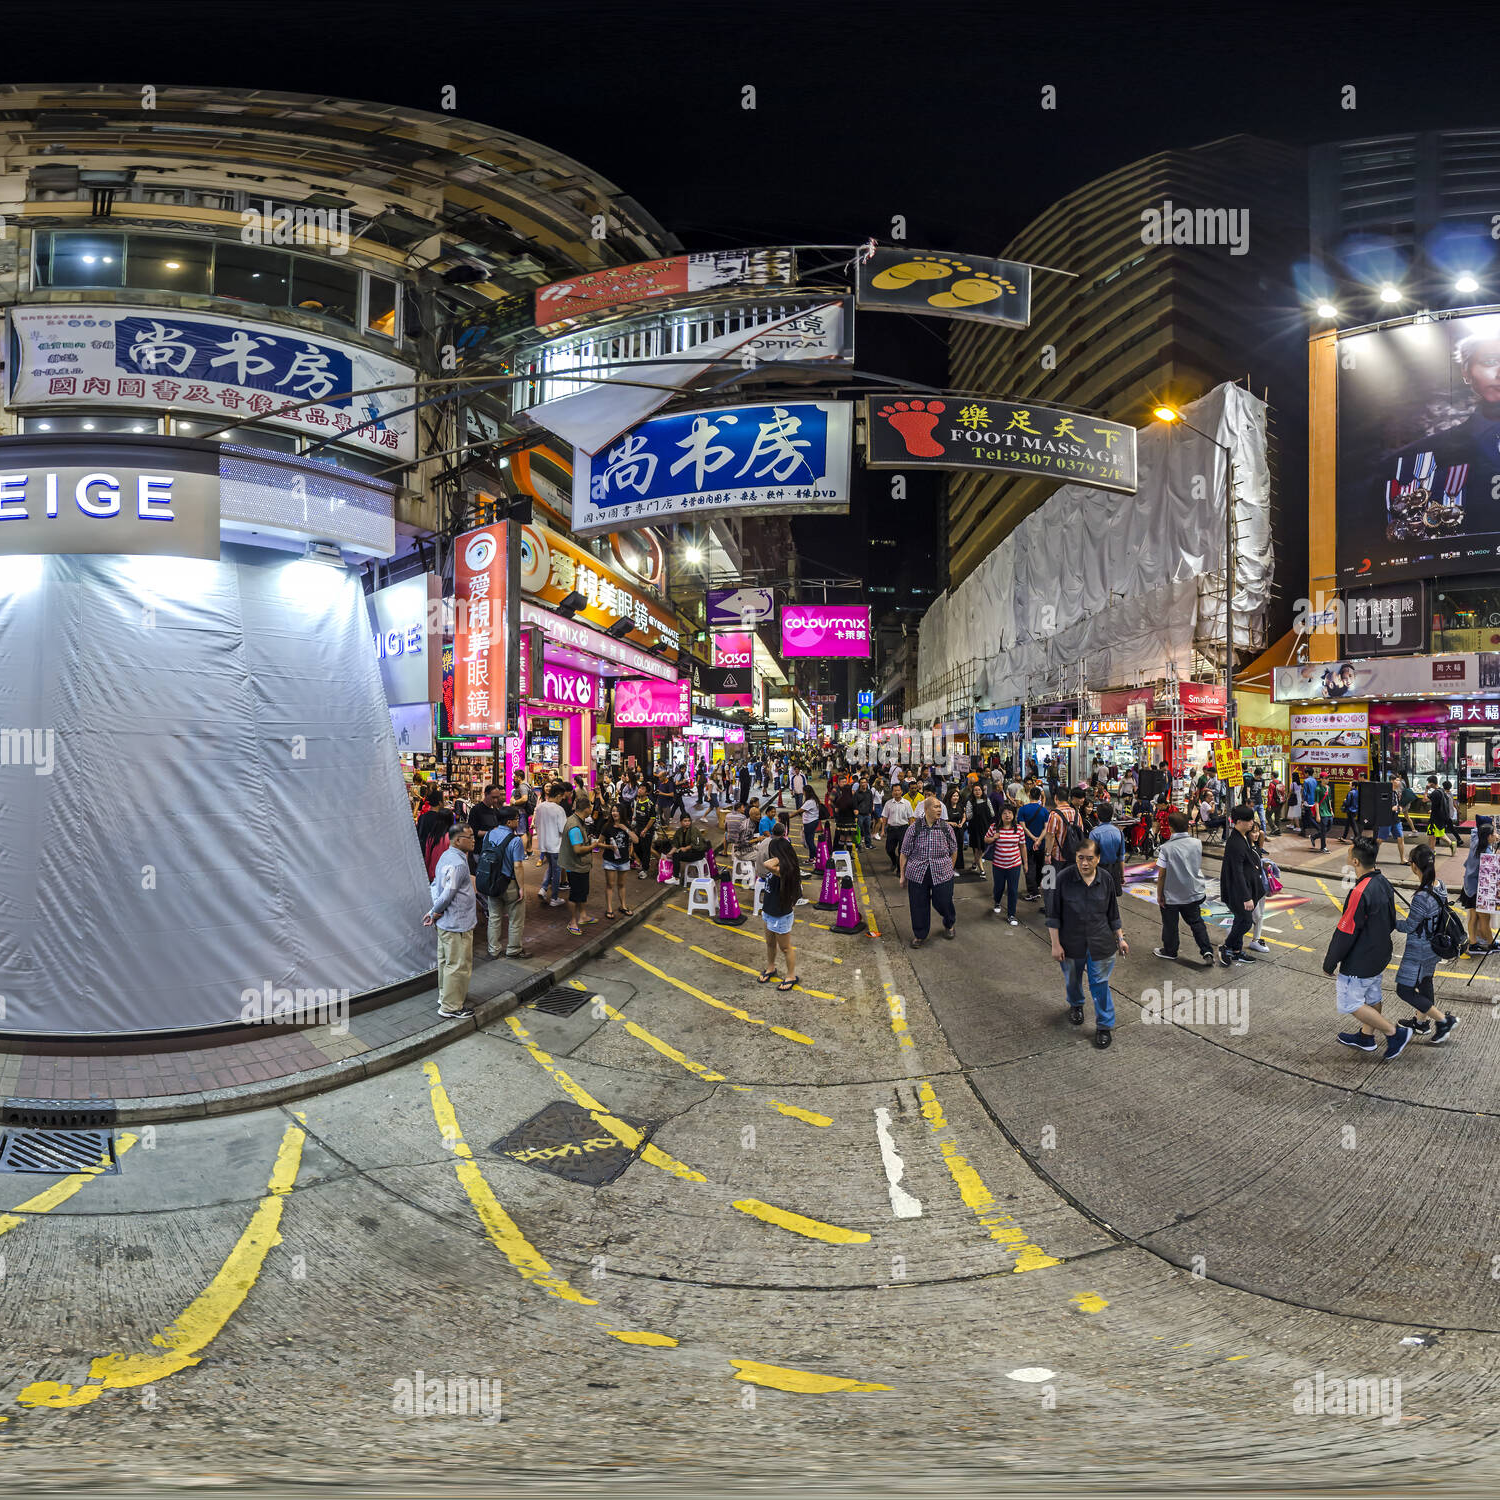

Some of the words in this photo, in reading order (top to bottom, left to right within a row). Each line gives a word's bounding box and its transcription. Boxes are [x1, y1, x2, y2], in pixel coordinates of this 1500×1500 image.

[128, 321, 339, 399] 尚书房
[748, 340, 828, 349] OPTICAL
[956, 403, 1122, 449] 樂足天下
[603, 407, 812, 495] 尚书房
[951, 429, 1016, 446] FOOT
[1022, 436, 1124, 466] MASSAGE
[972, 447, 1051, 465] Tel:9307
[1056, 458, 1095, 474] 0379
[1099, 465, 1124, 480] 2/F
[1436, 663, 1462, 672] 周大福
[1188, 694, 1219, 705] SmarTone
[1450, 704, 1499, 721] 周大福
